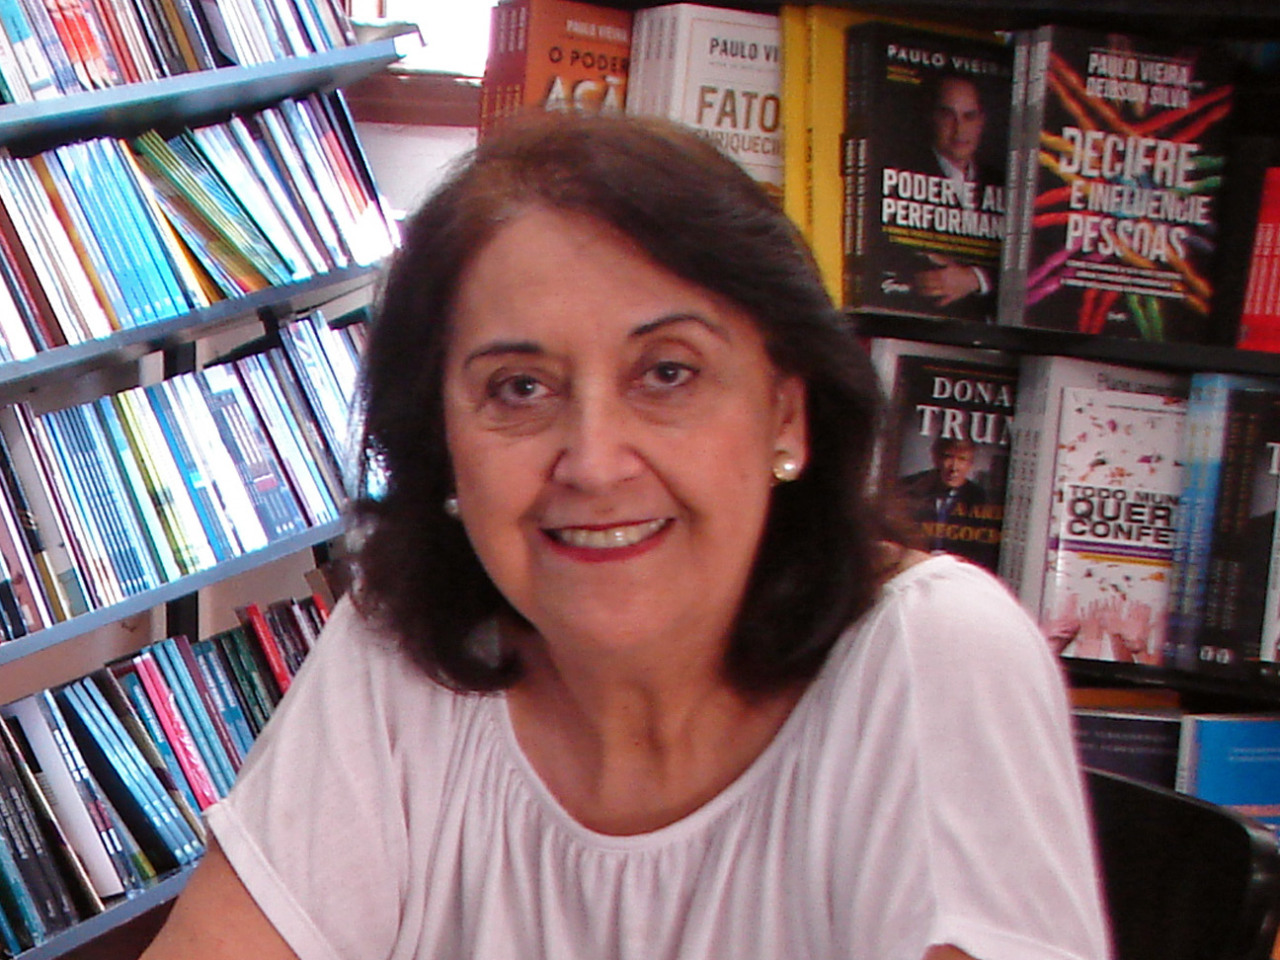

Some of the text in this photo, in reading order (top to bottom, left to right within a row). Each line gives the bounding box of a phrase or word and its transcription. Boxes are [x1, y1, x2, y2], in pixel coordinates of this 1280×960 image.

[549, 46, 563, 63] O
[710, 38, 758, 60] PAULO
[887, 44, 945, 67] PAULO
[1088, 53, 1190, 86] PAULO VIEIRA
[1059, 127, 1200, 189] DECIFRE
[883, 168, 957, 206] PODER
[962, 181, 977, 209] E
[1071, 180, 1212, 225] E INFLUENCIE
[1066, 214, 1188, 262] PESSOAS
[932, 376, 1012, 407] DONA
[1068, 484, 1127, 501] TODO
[1069, 498, 1173, 527] QUER
[1067, 519, 1177, 545] CONFE
